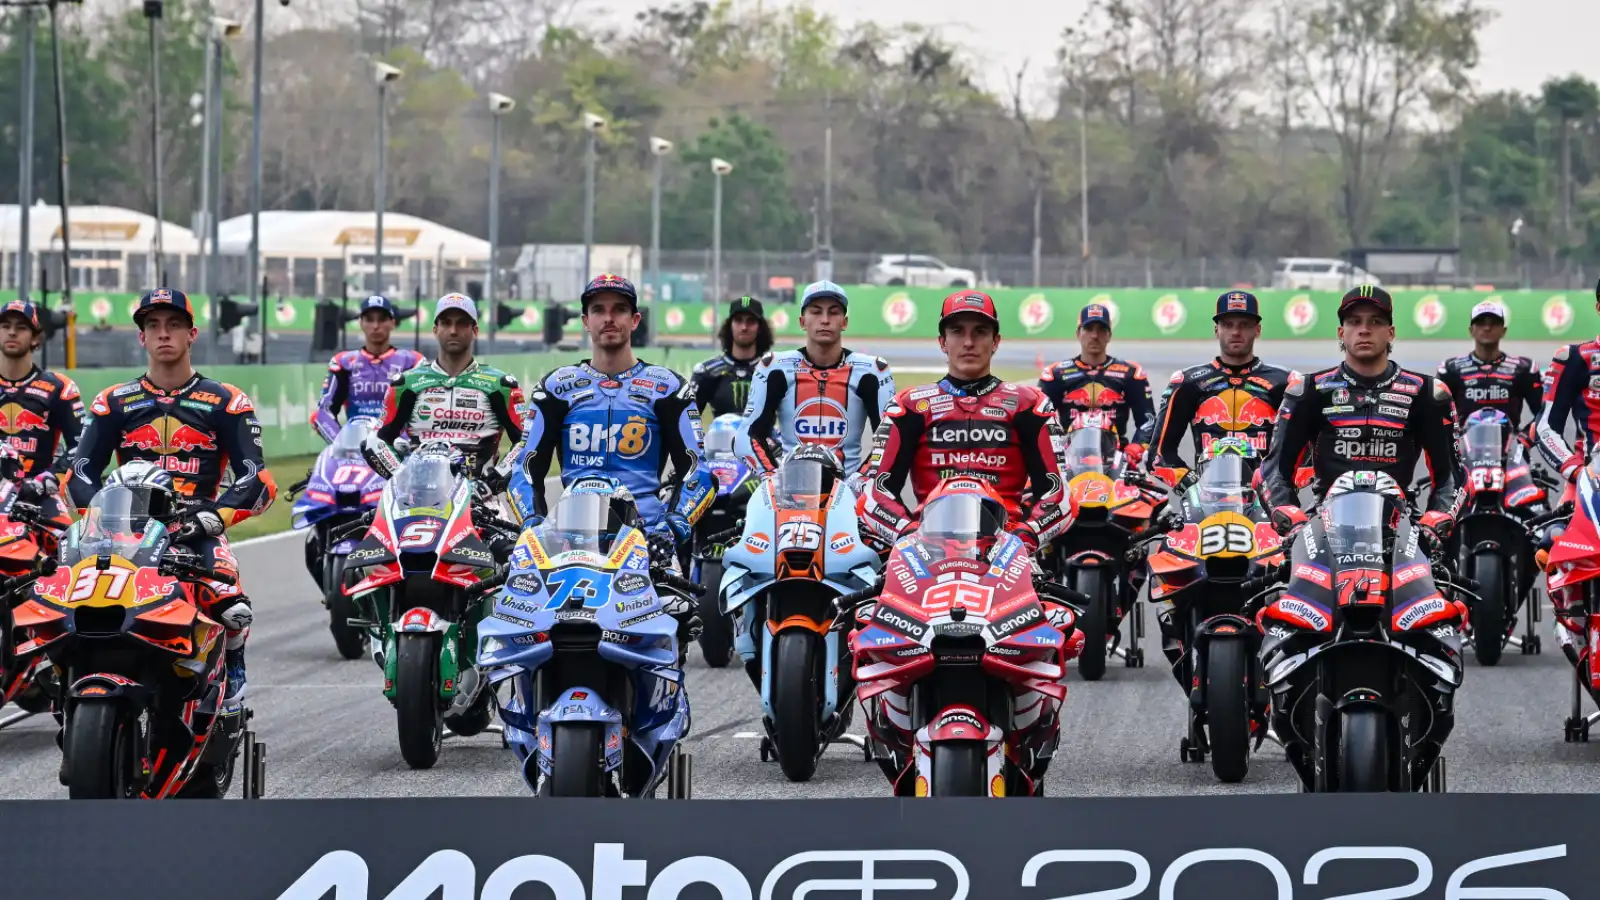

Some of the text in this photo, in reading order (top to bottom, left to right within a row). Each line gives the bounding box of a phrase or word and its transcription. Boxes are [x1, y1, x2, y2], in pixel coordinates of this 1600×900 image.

[353, 381, 389, 396] prim
[976, 381, 997, 396] Lenovo
[1465, 385, 1509, 402] aprilia
[189, 391, 222, 405] KTM
[1387, 395, 1411, 403] Castrol
[434, 408, 484, 421] Castrol
[984, 409, 1004, 417] SHOEI
[432, 421, 485, 431] POWER1
[795, 419, 846, 436] Gulf
[1373, 428, 1403, 437] TARGA
[569, 421, 648, 454] BK8
[932, 426, 1007, 442] Lenovo
[1201, 431, 1233, 450] Re
[12, 437, 37, 452] Bull
[1334, 438, 1396, 459] aprilia
[571, 455, 604, 466] NEWS
[794, 452, 825, 460] SHARK
[949, 452, 1007, 467] NetApp
[166, 456, 199, 474] Bull
[708, 462, 737, 470] ENEOS
[331, 464, 371, 484] 07
[875, 507, 897, 524] Lenovo
[1038, 509, 1060, 527] Lenovo
[370, 526, 392, 547] SENA
[447, 526, 474, 548] SENA
[746, 536, 770, 550] Gulf
[777, 521, 825, 555] 25
[830, 536, 856, 550] Gulf
[1201, 523, 1254, 555] 33
[611, 533, 638, 566] Antangin
[1558, 540, 1595, 551] HONDA
[514, 547, 533, 569] BK8
[568, 556, 598, 564] GLOBAL
[627, 547, 647, 569] BK8
[1336, 554, 1384, 564] TARGA
[1005, 555, 1029, 584] riello
[1296, 566, 1326, 581] BS
[1396, 566, 1429, 581] BS
[68, 566, 134, 603] 37
[515, 576, 538, 588] Estrella
[618, 576, 643, 587] Estrella
[621, 581, 645, 592] Galicia
[892, 564, 918, 594] riello
[512, 582, 534, 593] Galicia
[543, 566, 614, 611] 73
[501, 595, 538, 614] Unibat
[615, 596, 653, 613] Unibat
[921, 580, 995, 616] 93
[876, 605, 923, 637] Lenovo
[1281, 600, 1325, 630] sterilgarda
[1399, 598, 1443, 629] sterilgarda
[944, 623, 981, 632] MONSTER
[992, 608, 1040, 635] Lenovo
[602, 630, 629, 642] BOLD
[1269, 627, 1291, 640] sky
[1433, 623, 1454, 638] sky
[513, 634, 533, 644] BOLD
[876, 636, 895, 645] TIM
[1036, 636, 1056, 645] TIM
[897, 647, 928, 656] CARRERA
[989, 646, 1020, 655] CARRERA
